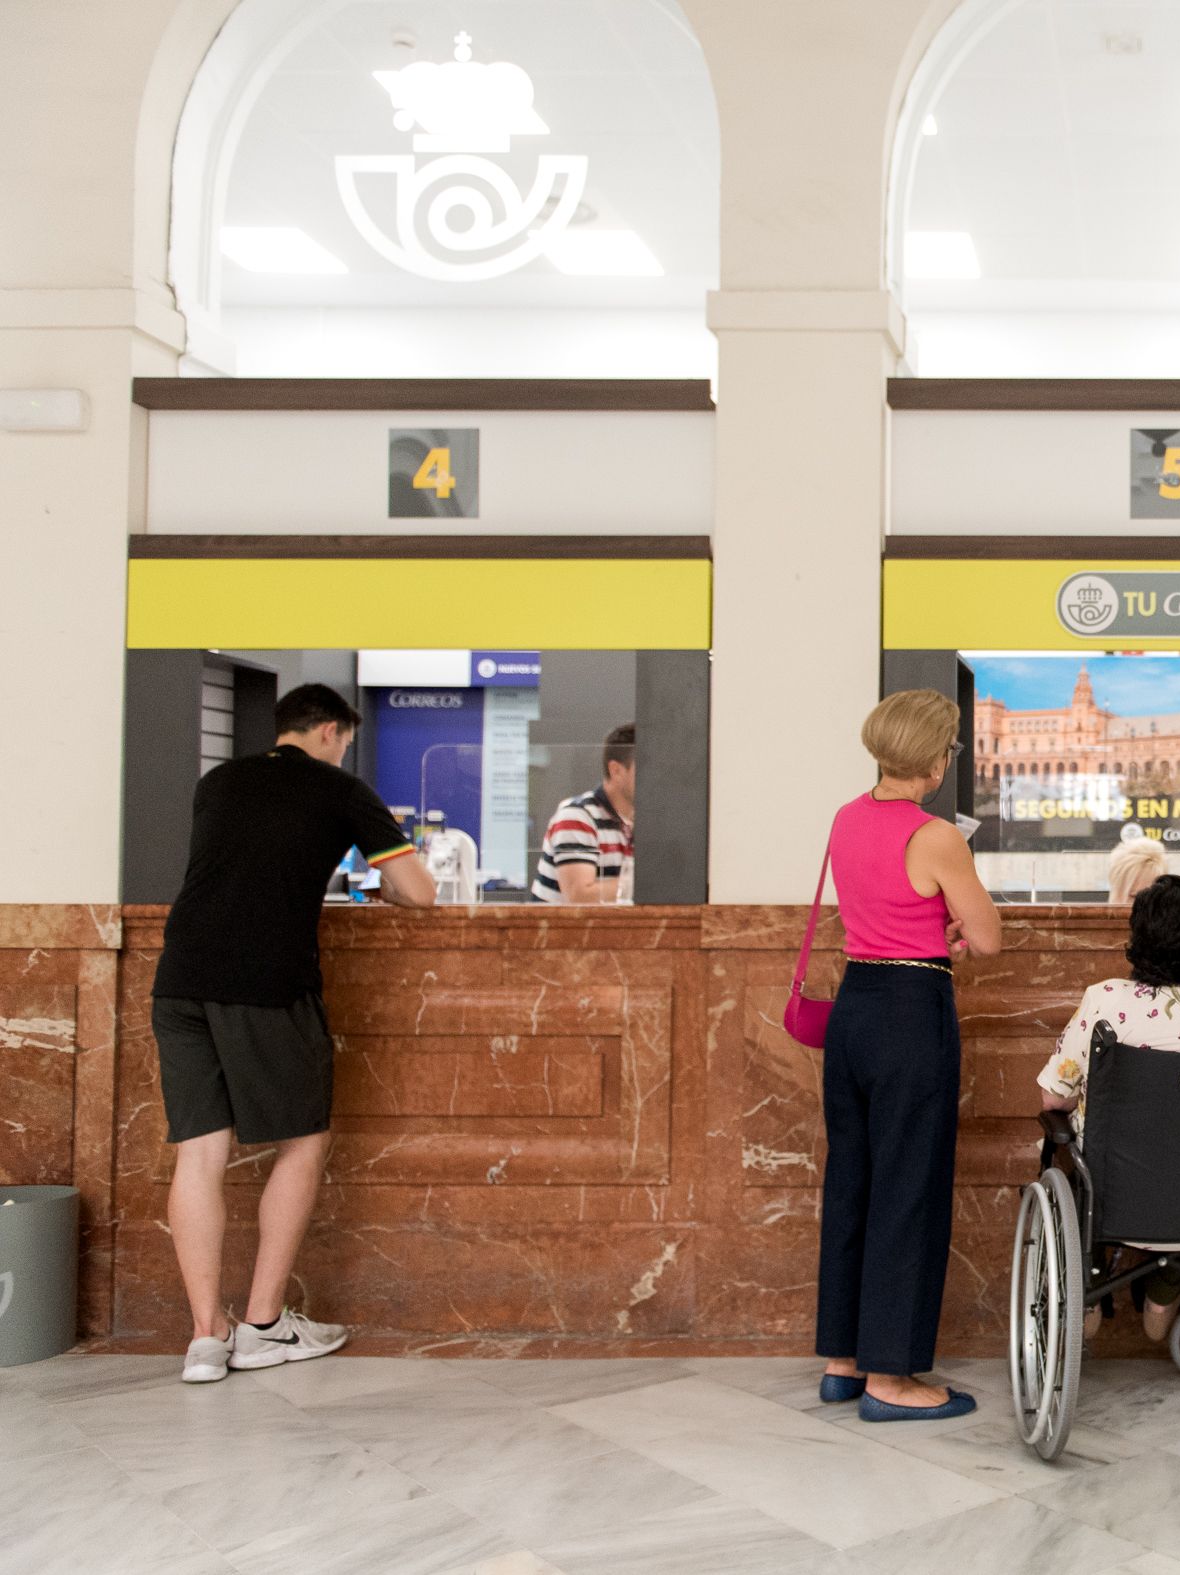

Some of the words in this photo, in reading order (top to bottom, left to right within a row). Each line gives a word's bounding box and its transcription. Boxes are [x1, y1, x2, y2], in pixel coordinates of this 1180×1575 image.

[412, 447, 456, 499] 4
[1123, 591, 1157, 617] TU
[1137, 799, 1168, 818] EN
[1145, 827, 1162, 841] TU
